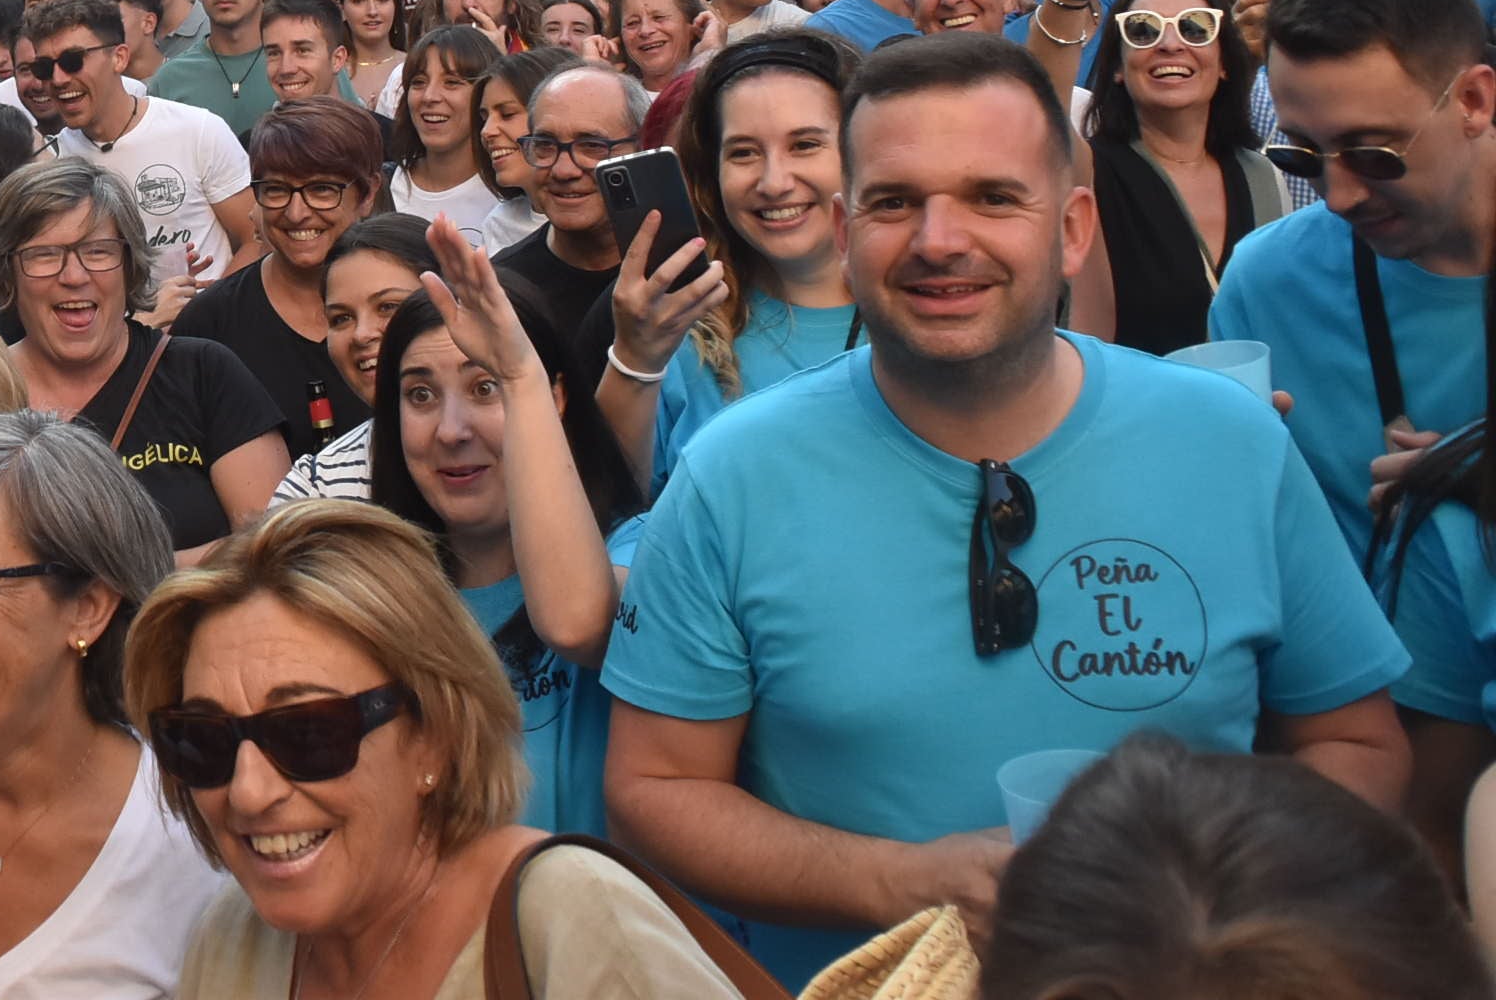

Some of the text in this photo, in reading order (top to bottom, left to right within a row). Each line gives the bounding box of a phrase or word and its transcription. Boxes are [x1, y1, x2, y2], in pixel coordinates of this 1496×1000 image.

[148, 225, 192, 247] dero
[1070, 554, 1159, 590] Peña
[616, 601, 639, 635] vid
[1094, 593, 1143, 637] El
[1052, 638, 1196, 683] Cantón
